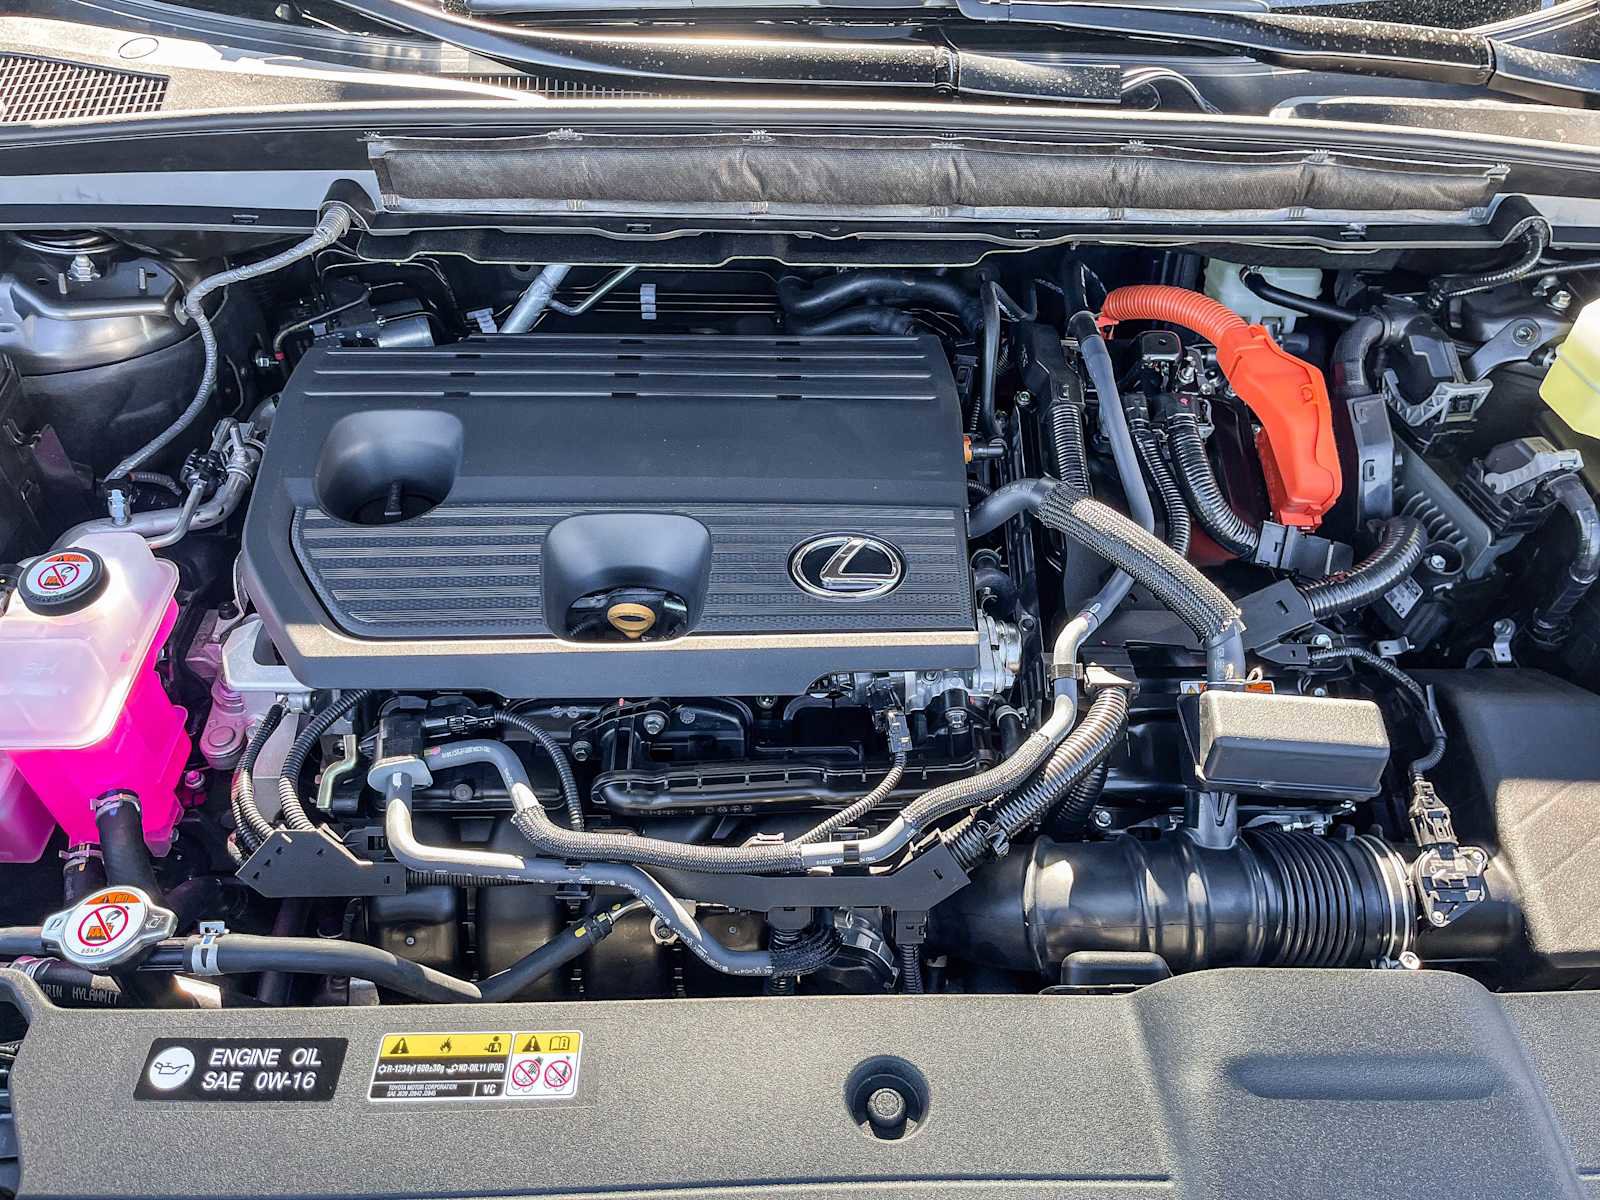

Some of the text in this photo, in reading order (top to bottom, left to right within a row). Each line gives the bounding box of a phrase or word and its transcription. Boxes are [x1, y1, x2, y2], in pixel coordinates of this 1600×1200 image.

[209, 1047, 322, 1066] ENGINE OIL
[202, 1071, 317, 1089] SAE 0W-16
[483, 1083, 497, 1095] VC
